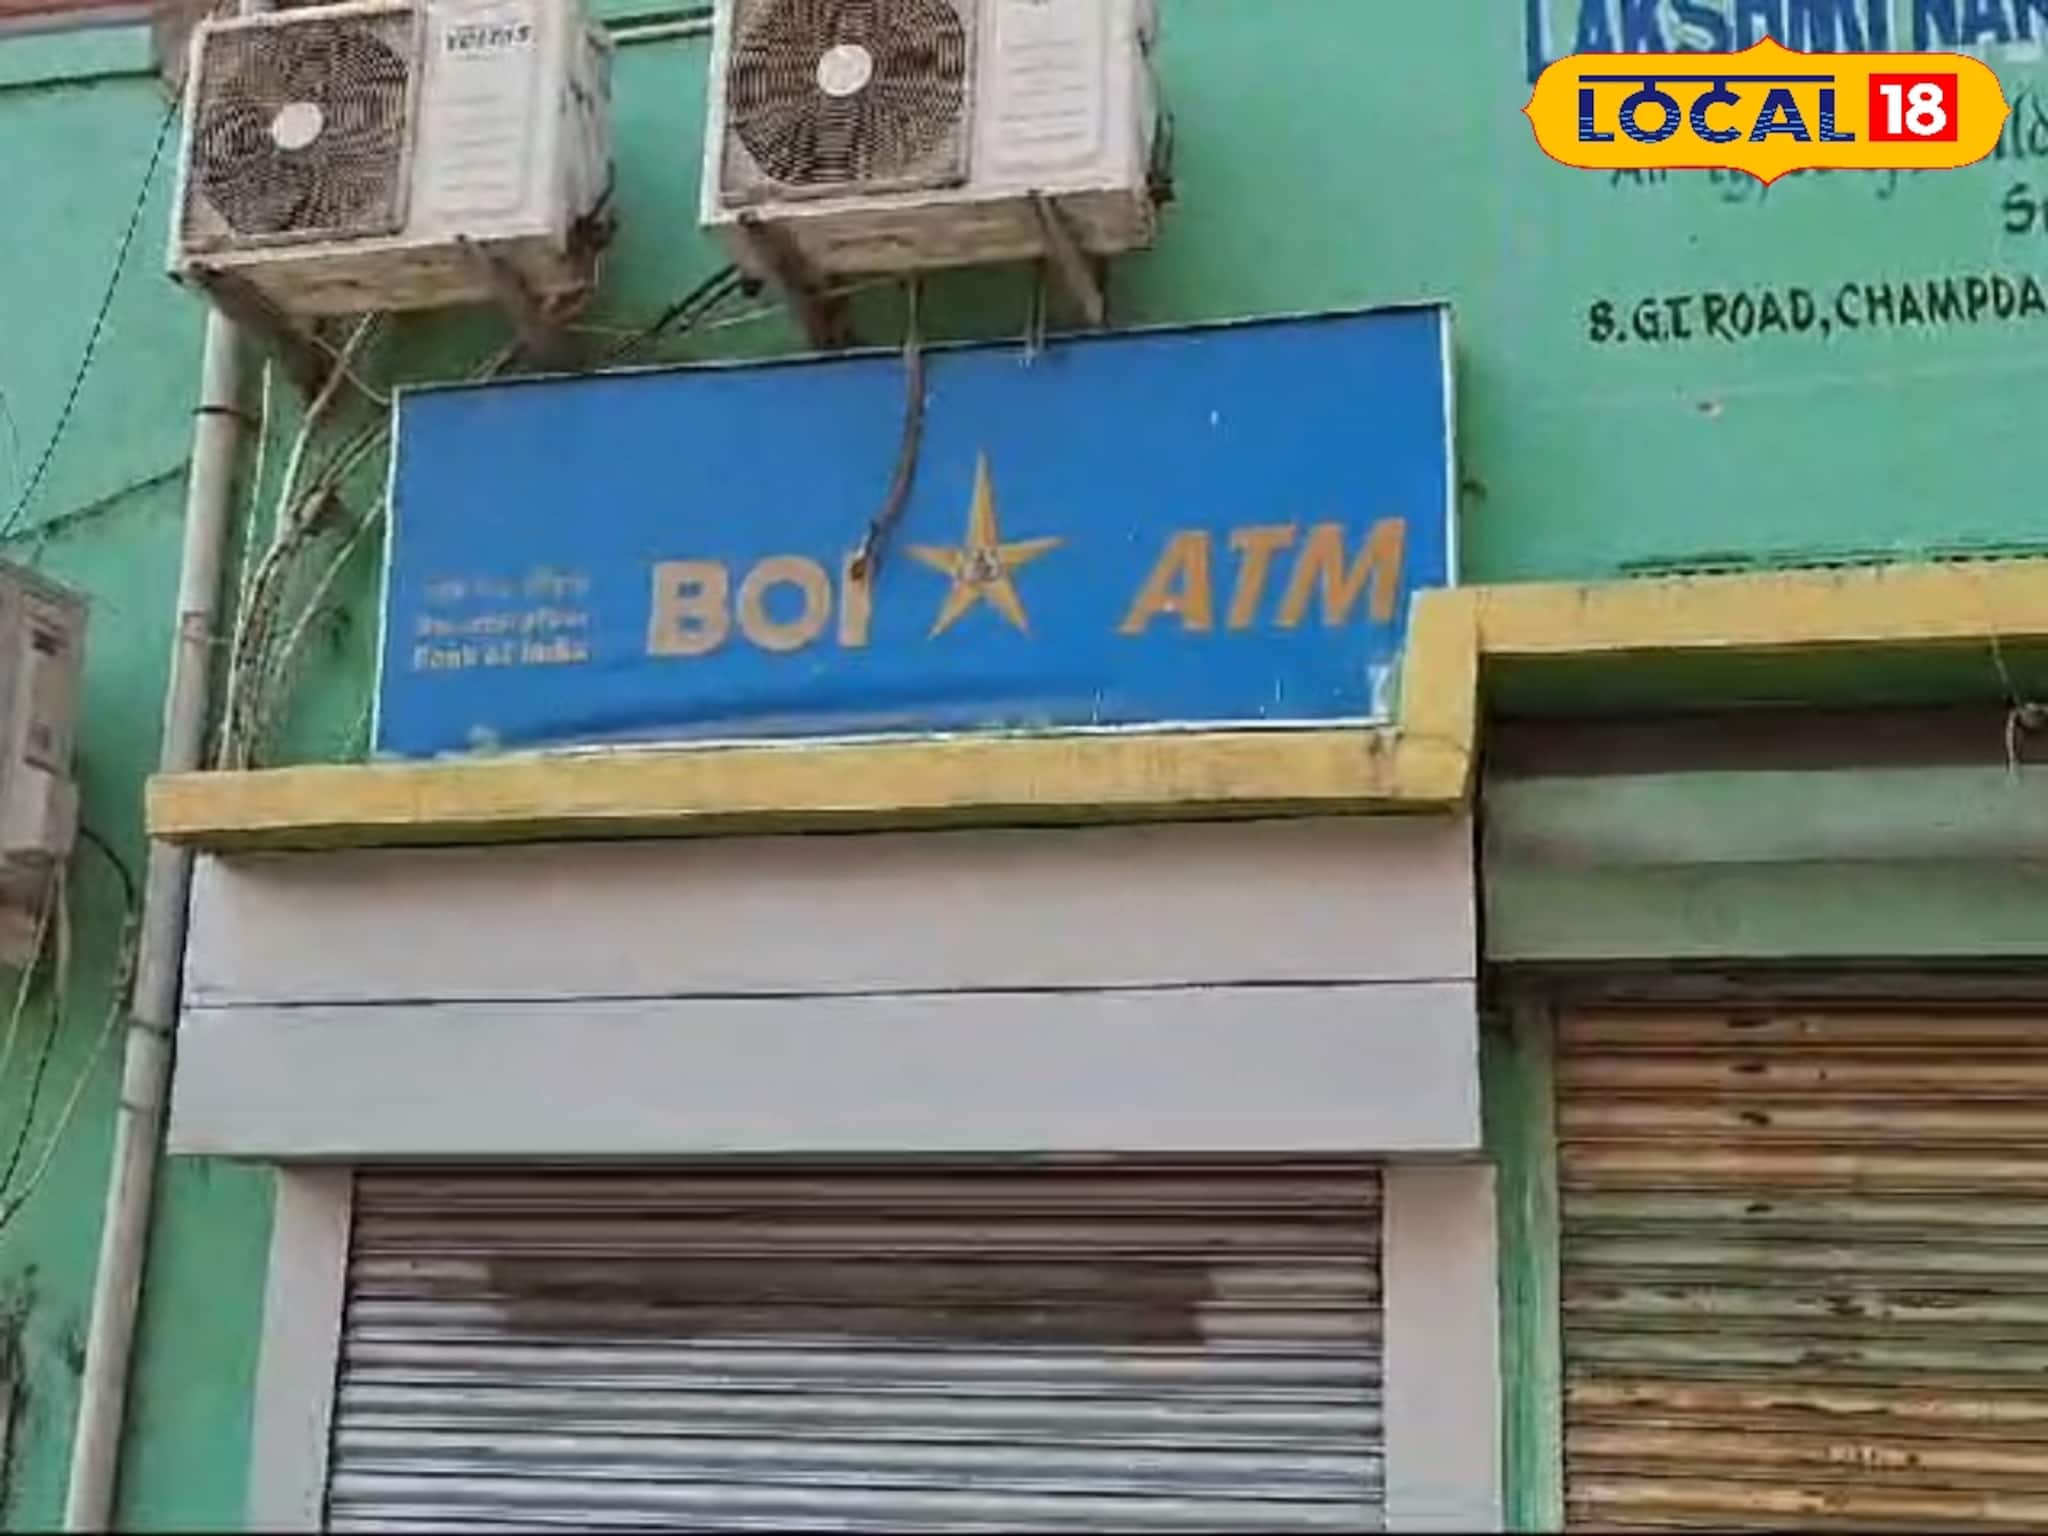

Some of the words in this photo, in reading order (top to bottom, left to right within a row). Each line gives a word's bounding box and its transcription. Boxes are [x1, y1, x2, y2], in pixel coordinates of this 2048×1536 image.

[1836, 273, 2048, 329] CHAMPDA
[646, 549, 872, 657] BOI
[1117, 517, 1406, 636] ATM
